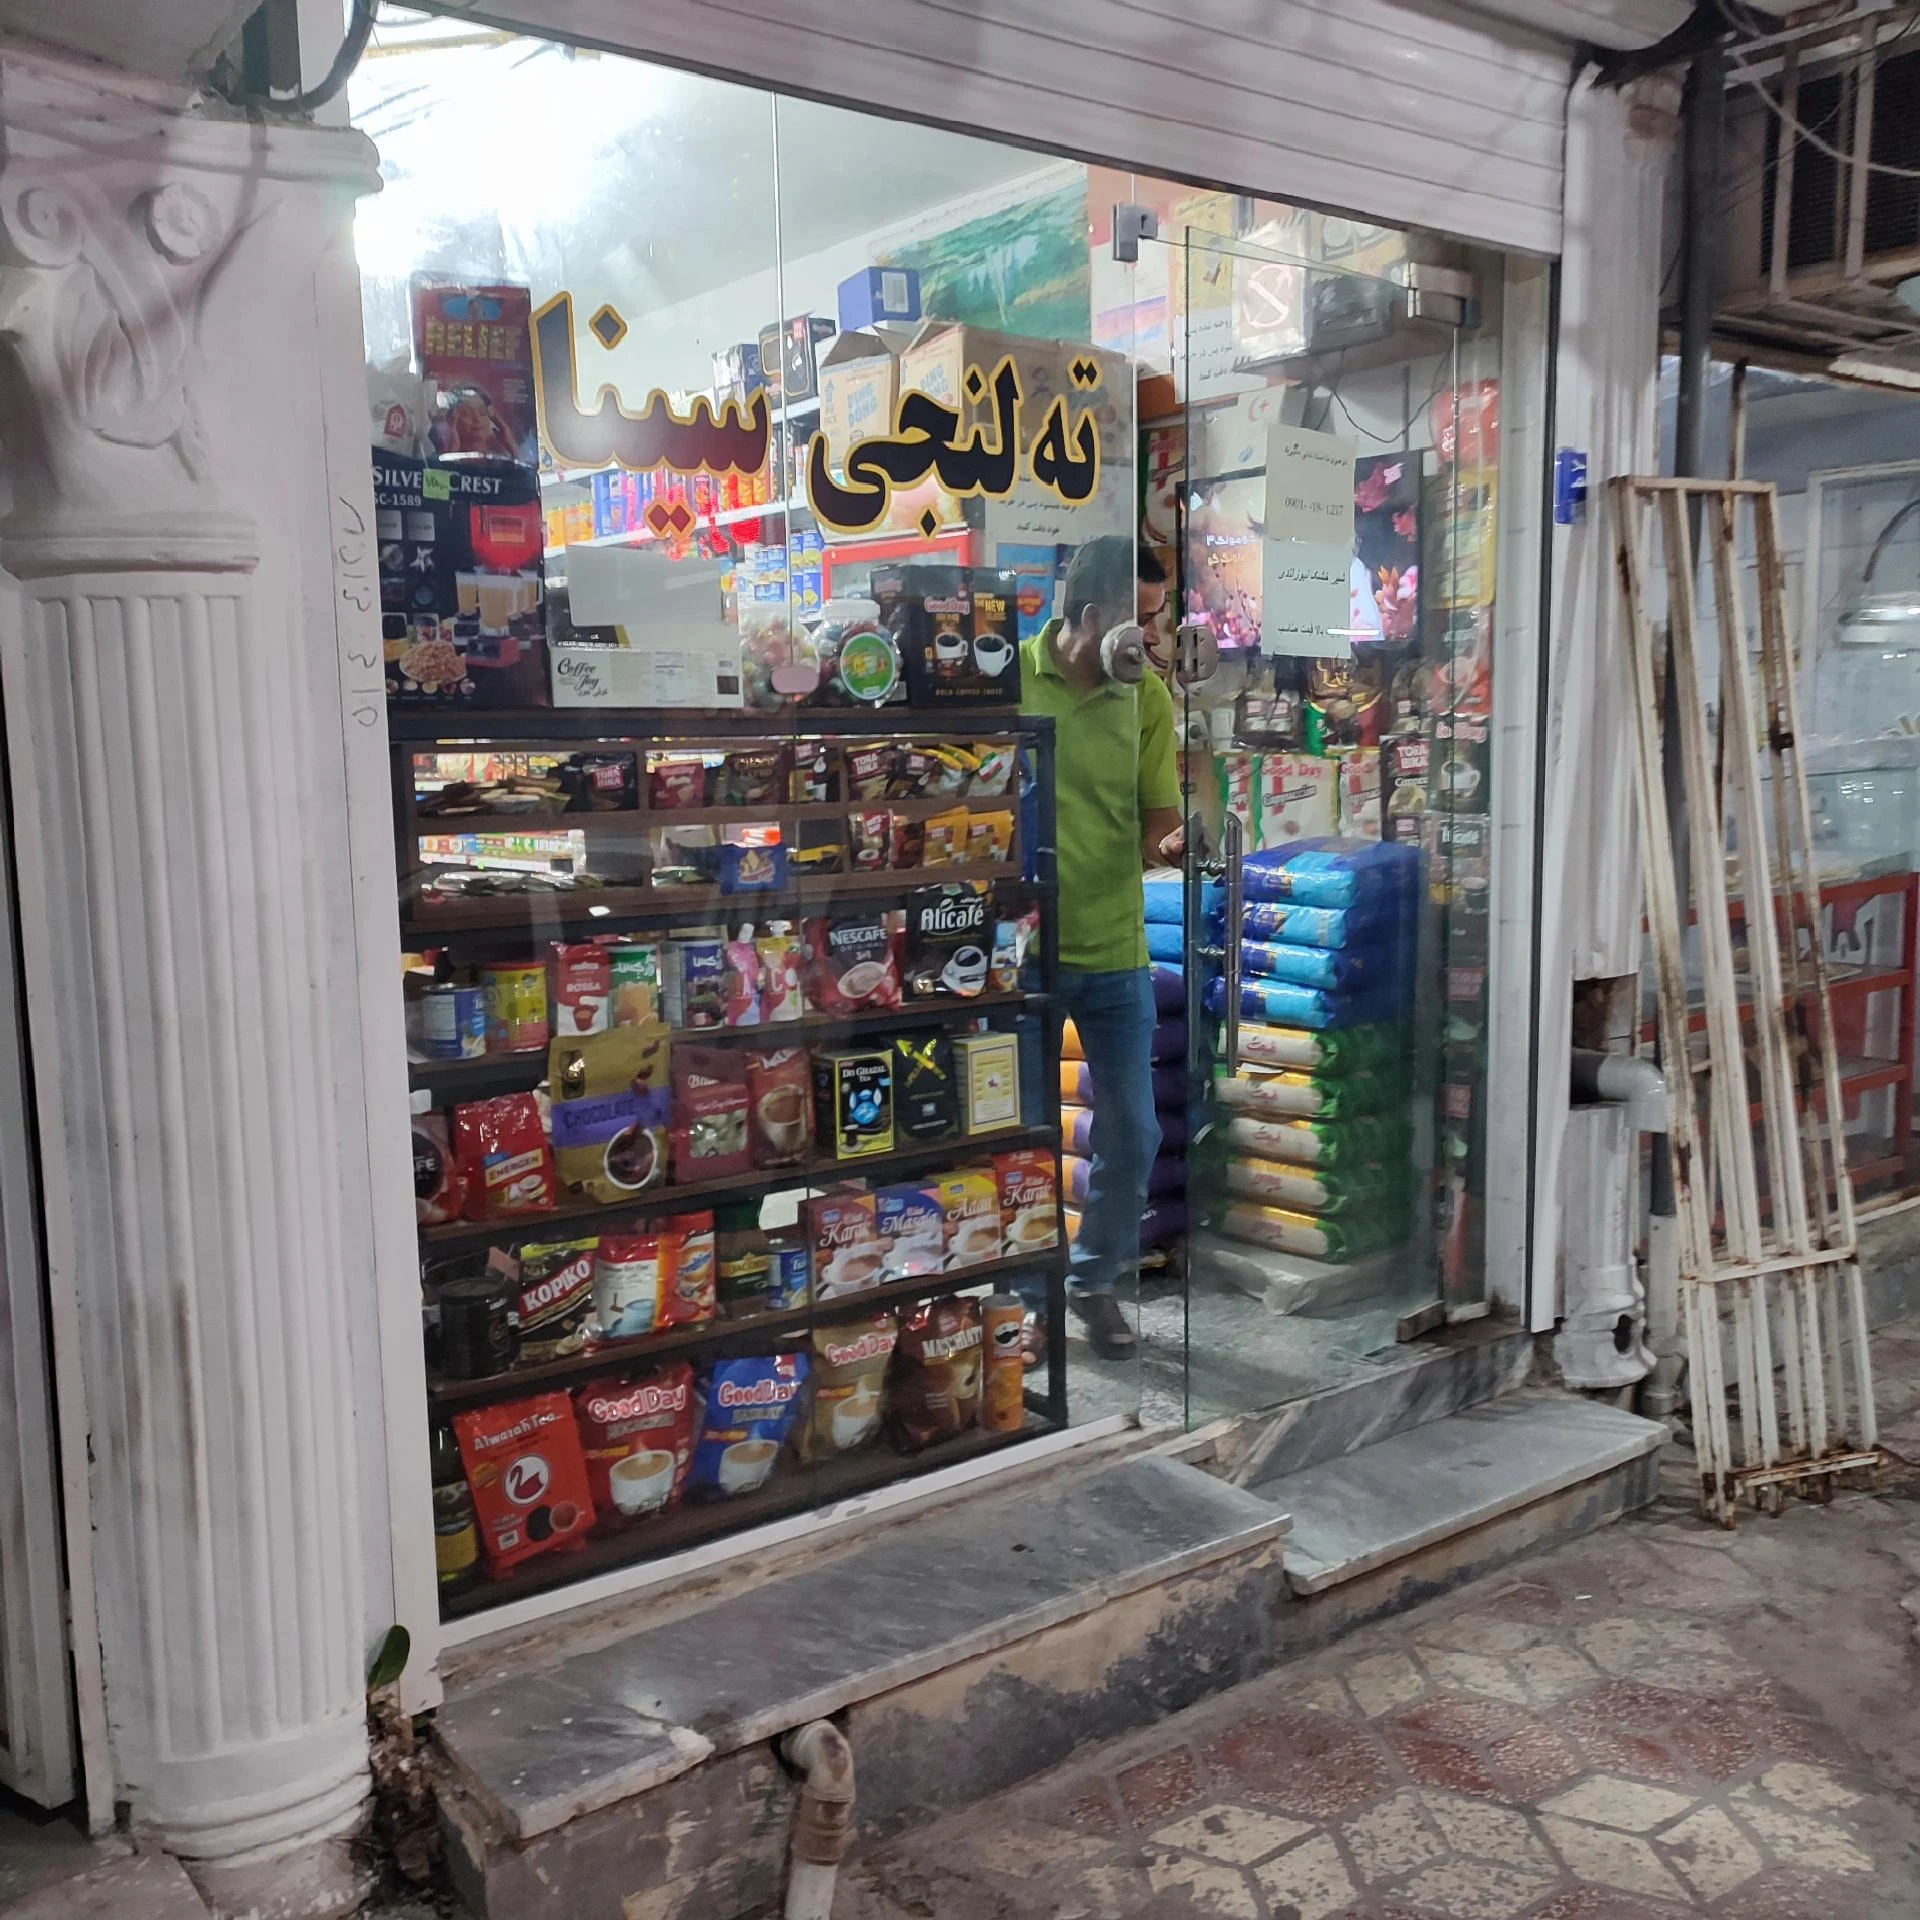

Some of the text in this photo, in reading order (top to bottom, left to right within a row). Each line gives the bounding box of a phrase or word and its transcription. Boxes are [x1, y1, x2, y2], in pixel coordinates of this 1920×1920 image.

[528, 290, 1101, 543] ته لنجی سینا
[985, 599, 1007, 613] NEW
[557, 656, 598, 677] Coffee
[574, 675, 601, 692] Joy
[921, 902, 984, 932] Alicafé
[489, 1155, 540, 1182] ENERGEN
[521, 1259, 591, 1313] KOPIKO
[473, 1420, 532, 1451] Alwazah
